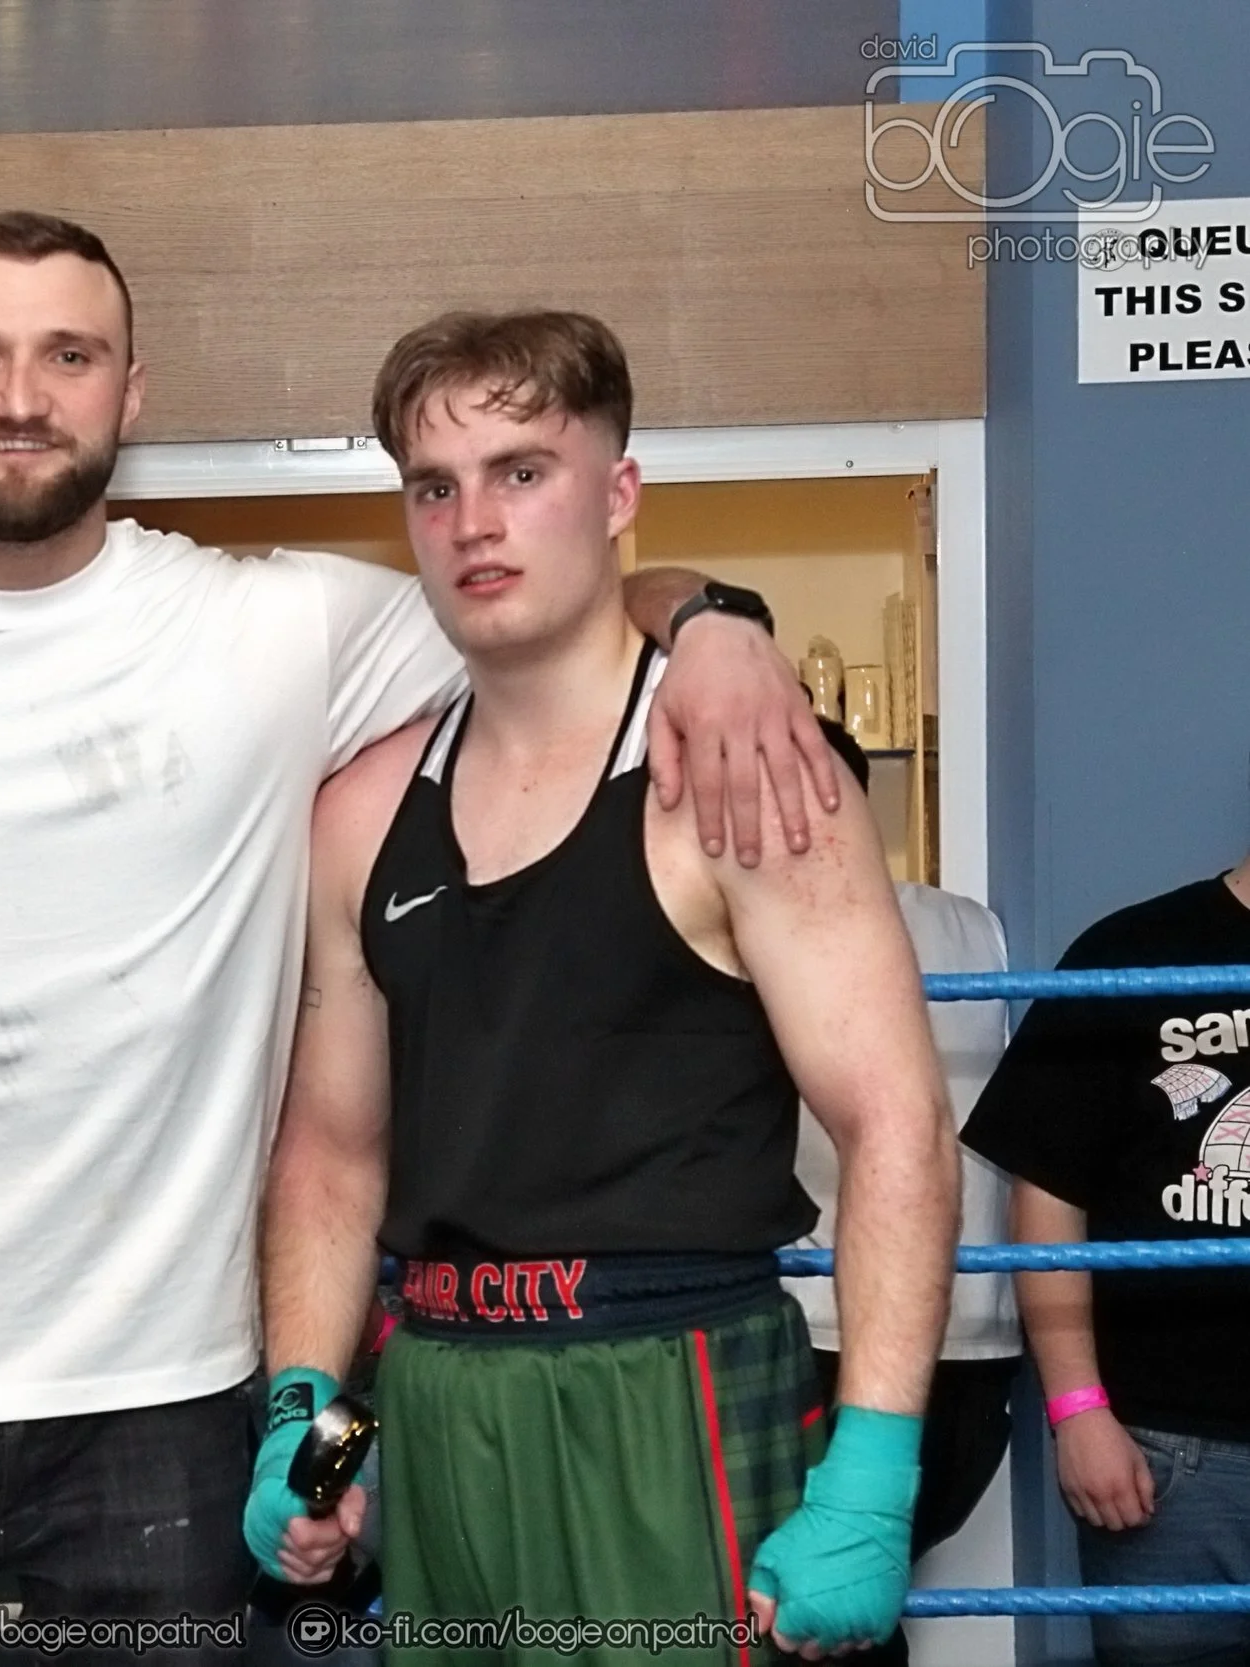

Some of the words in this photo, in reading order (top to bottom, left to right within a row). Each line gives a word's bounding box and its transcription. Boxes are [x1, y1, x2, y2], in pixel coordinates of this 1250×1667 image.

[1095, 284, 1202, 317] THIS
[1219, 282, 1245, 313] S
[1129, 338, 1250, 372] PLEA
[471, 1259, 587, 1322] CITY
